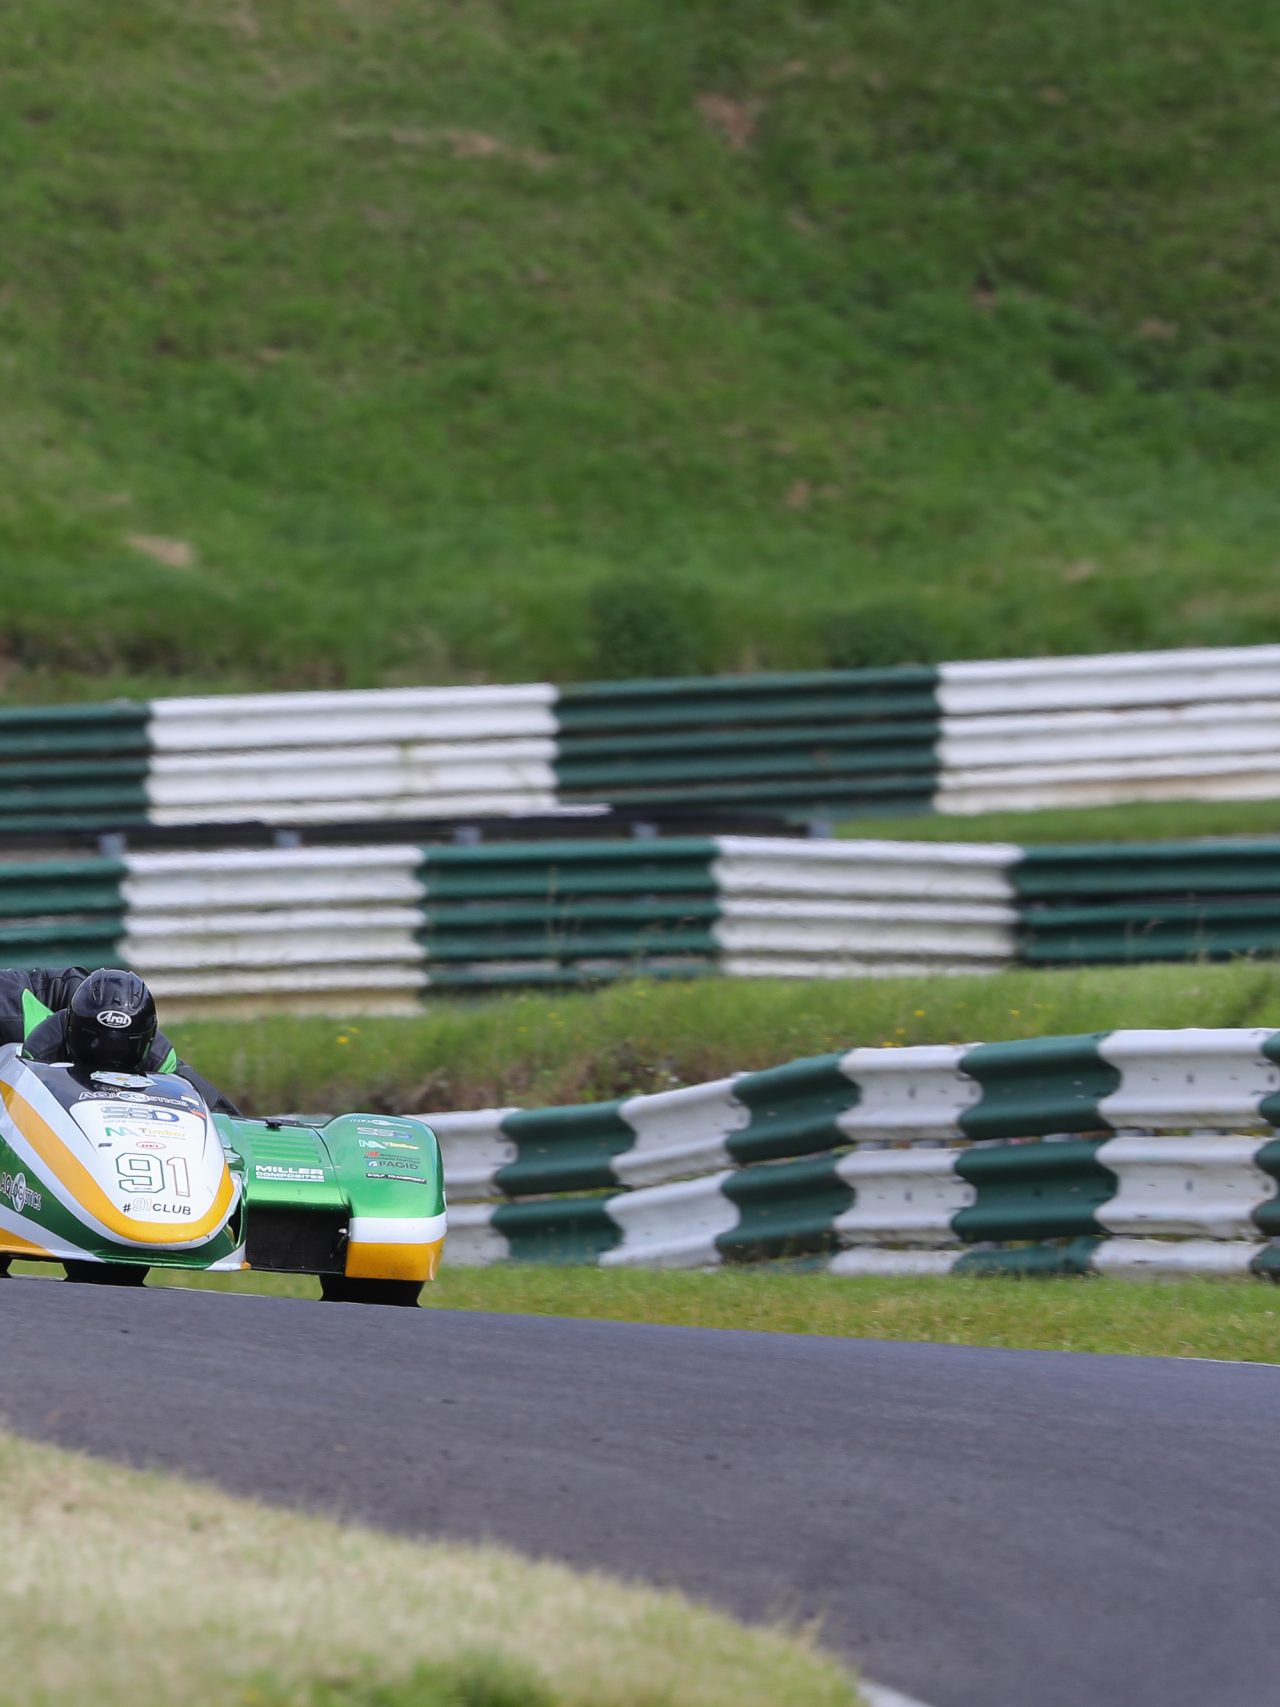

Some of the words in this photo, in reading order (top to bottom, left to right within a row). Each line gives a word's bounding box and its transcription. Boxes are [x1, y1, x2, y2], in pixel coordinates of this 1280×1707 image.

[255, 1164, 324, 1175] MILLER
[379, 1160, 419, 1170] PAGID
[115, 1152, 191, 1198] 91
[255, 1171, 324, 1179] COMPOSITES
